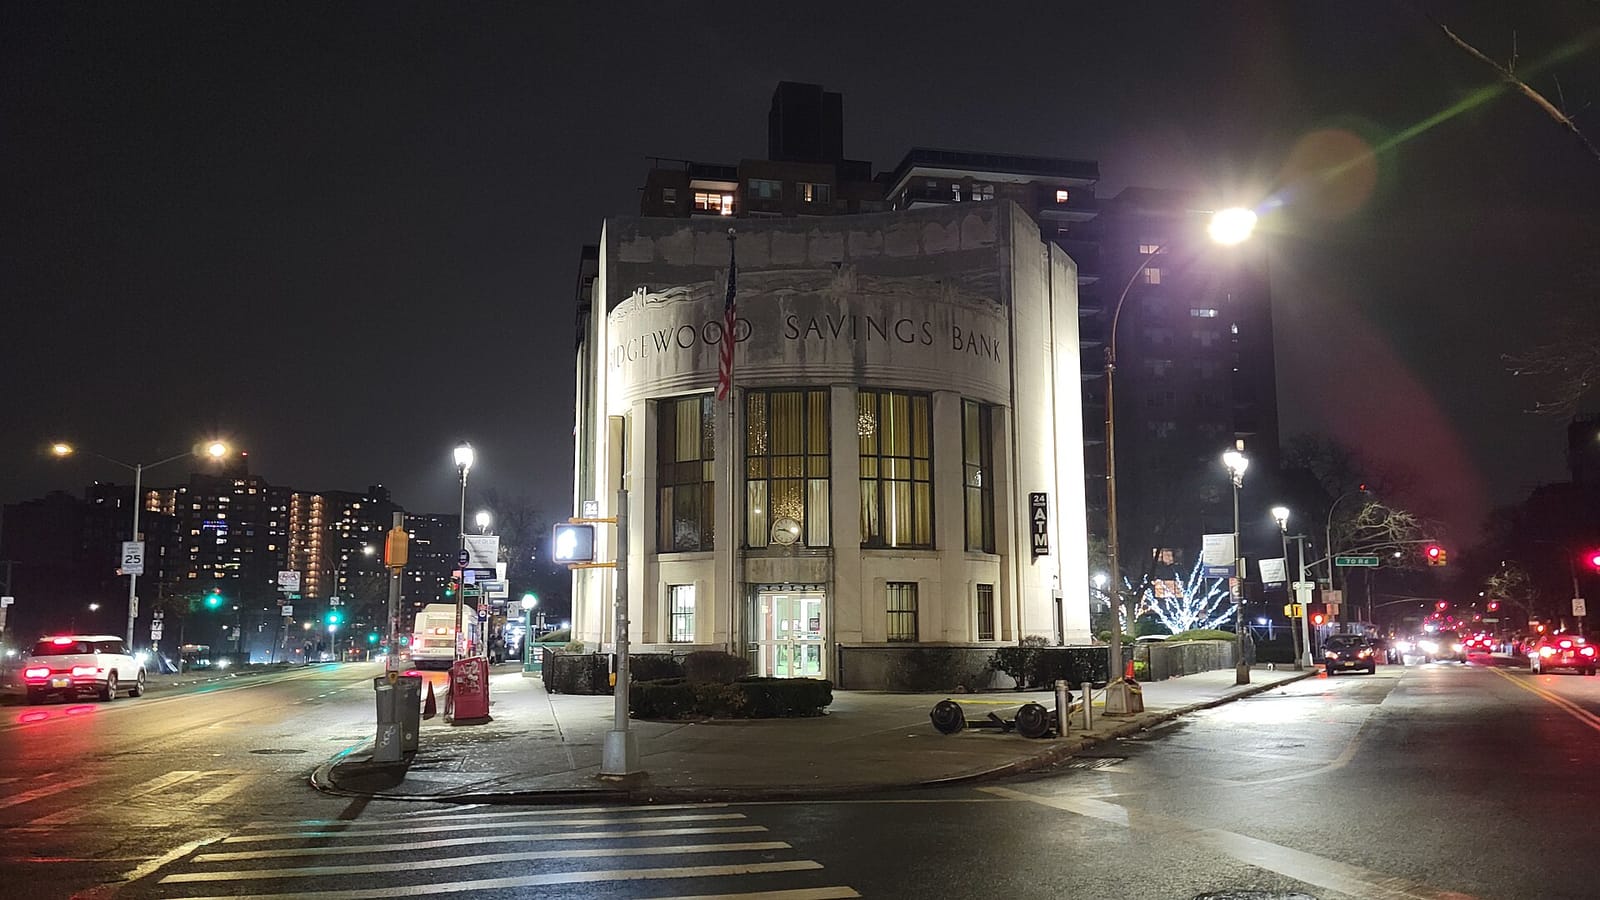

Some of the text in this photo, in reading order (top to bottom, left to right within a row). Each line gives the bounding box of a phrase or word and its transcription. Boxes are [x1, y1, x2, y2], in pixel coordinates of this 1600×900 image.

[784, 314, 934, 346] SAVINGS
[952, 325, 1002, 365] BANK
[1034, 507, 1047, 546] ATM
[125, 555, 141, 564] 25
